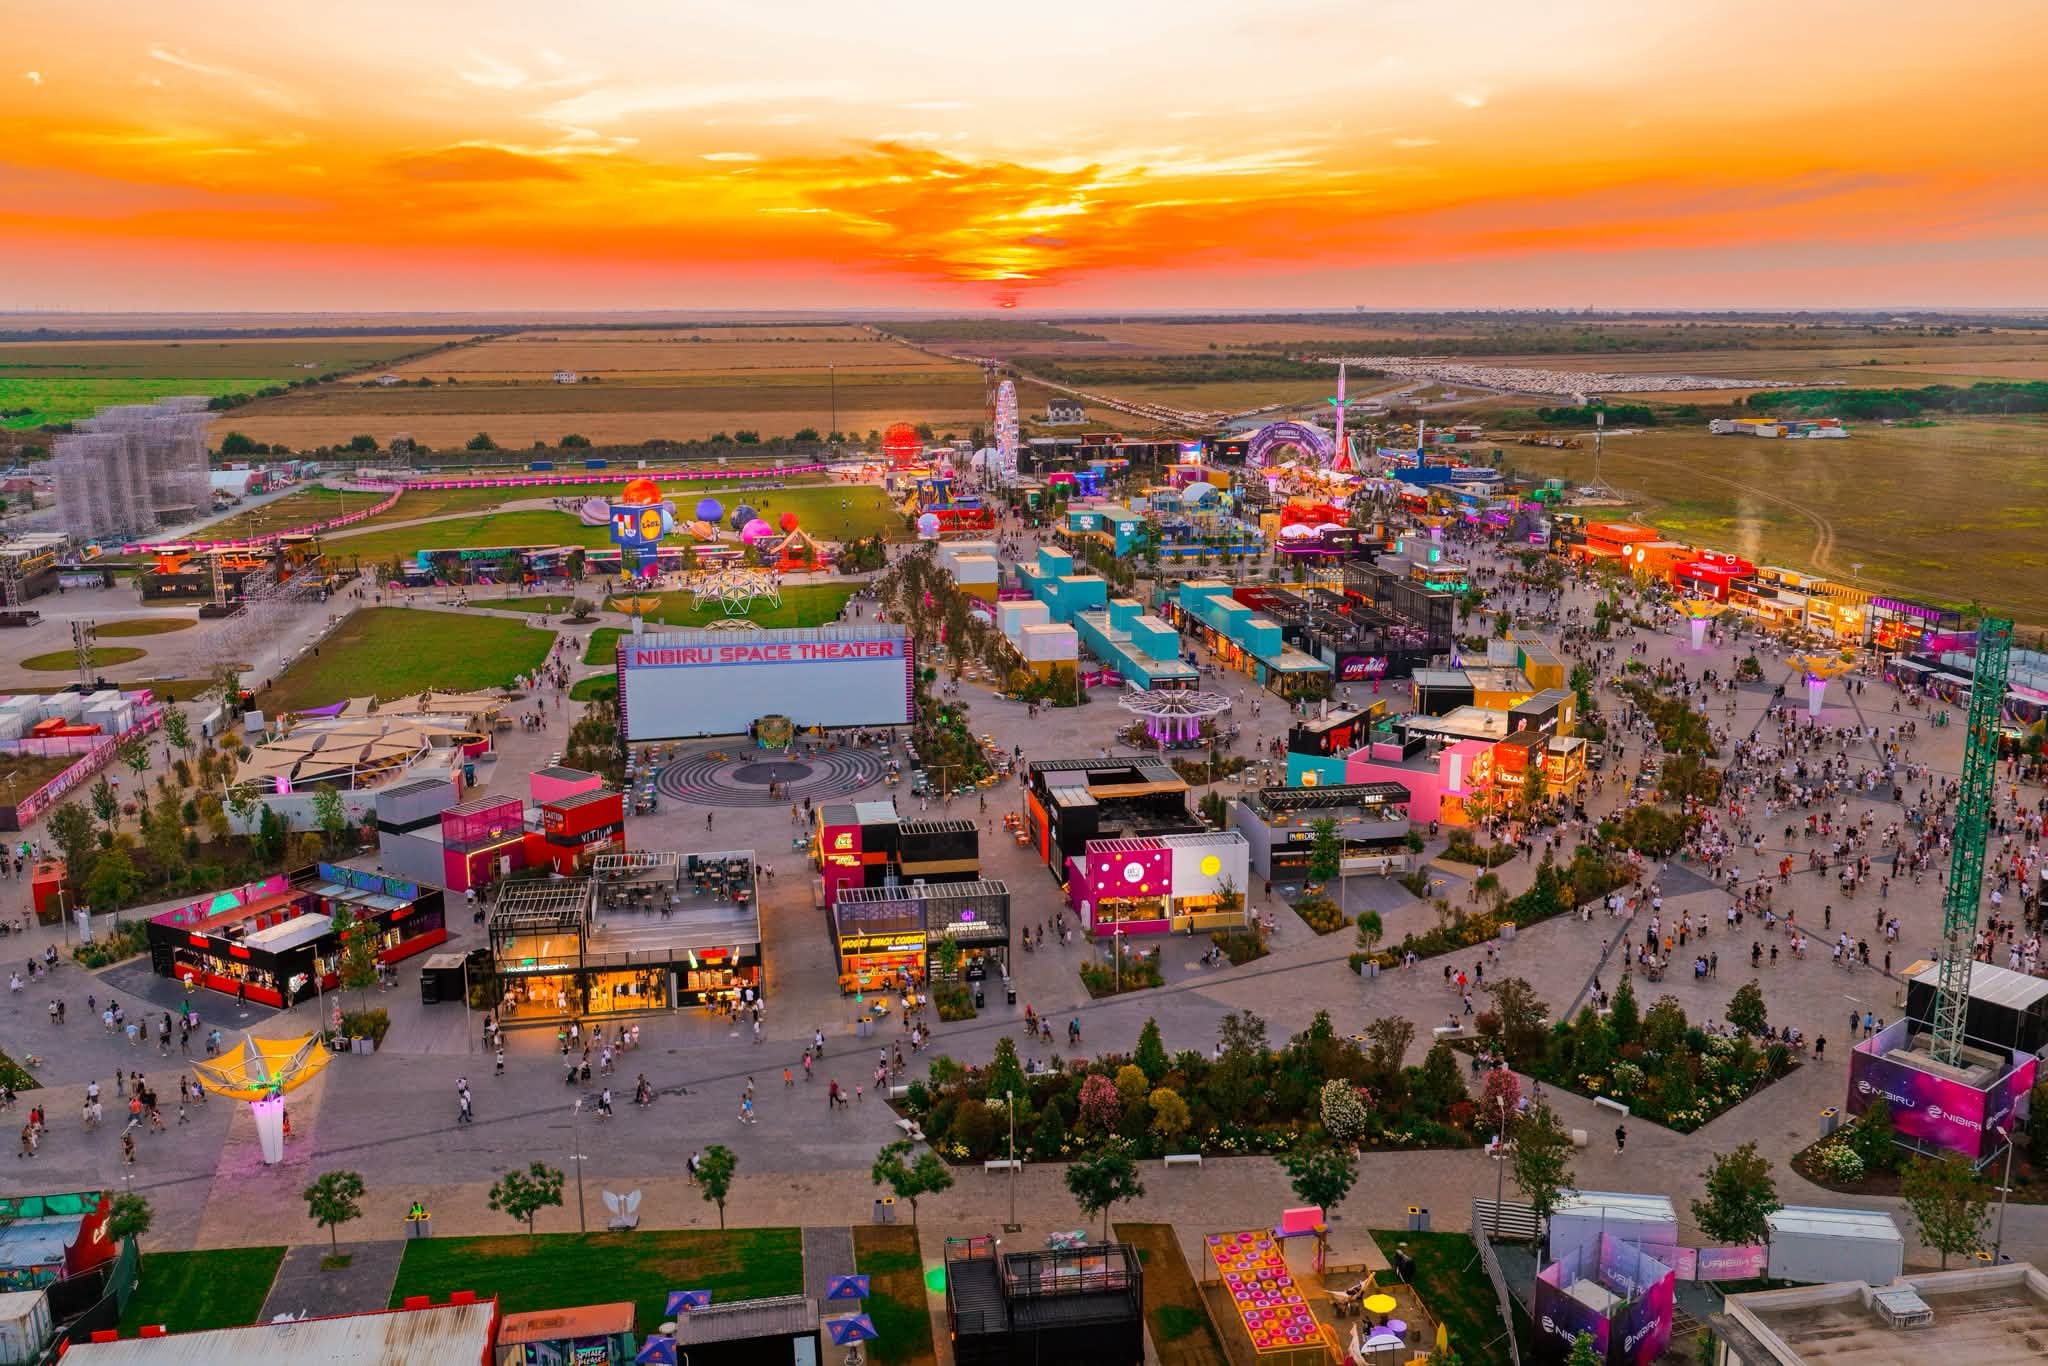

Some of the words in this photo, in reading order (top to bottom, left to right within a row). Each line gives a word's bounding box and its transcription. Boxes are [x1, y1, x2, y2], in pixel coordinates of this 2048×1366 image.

[637, 648, 712, 665] NIBIRU
[720, 645, 791, 662] SPACE
[798, 641, 894, 659] THEATER
[1345, 664, 1364, 672] LIVE
[581, 825, 613, 843] VITIUM
[895, 934, 925, 945] CORNER
